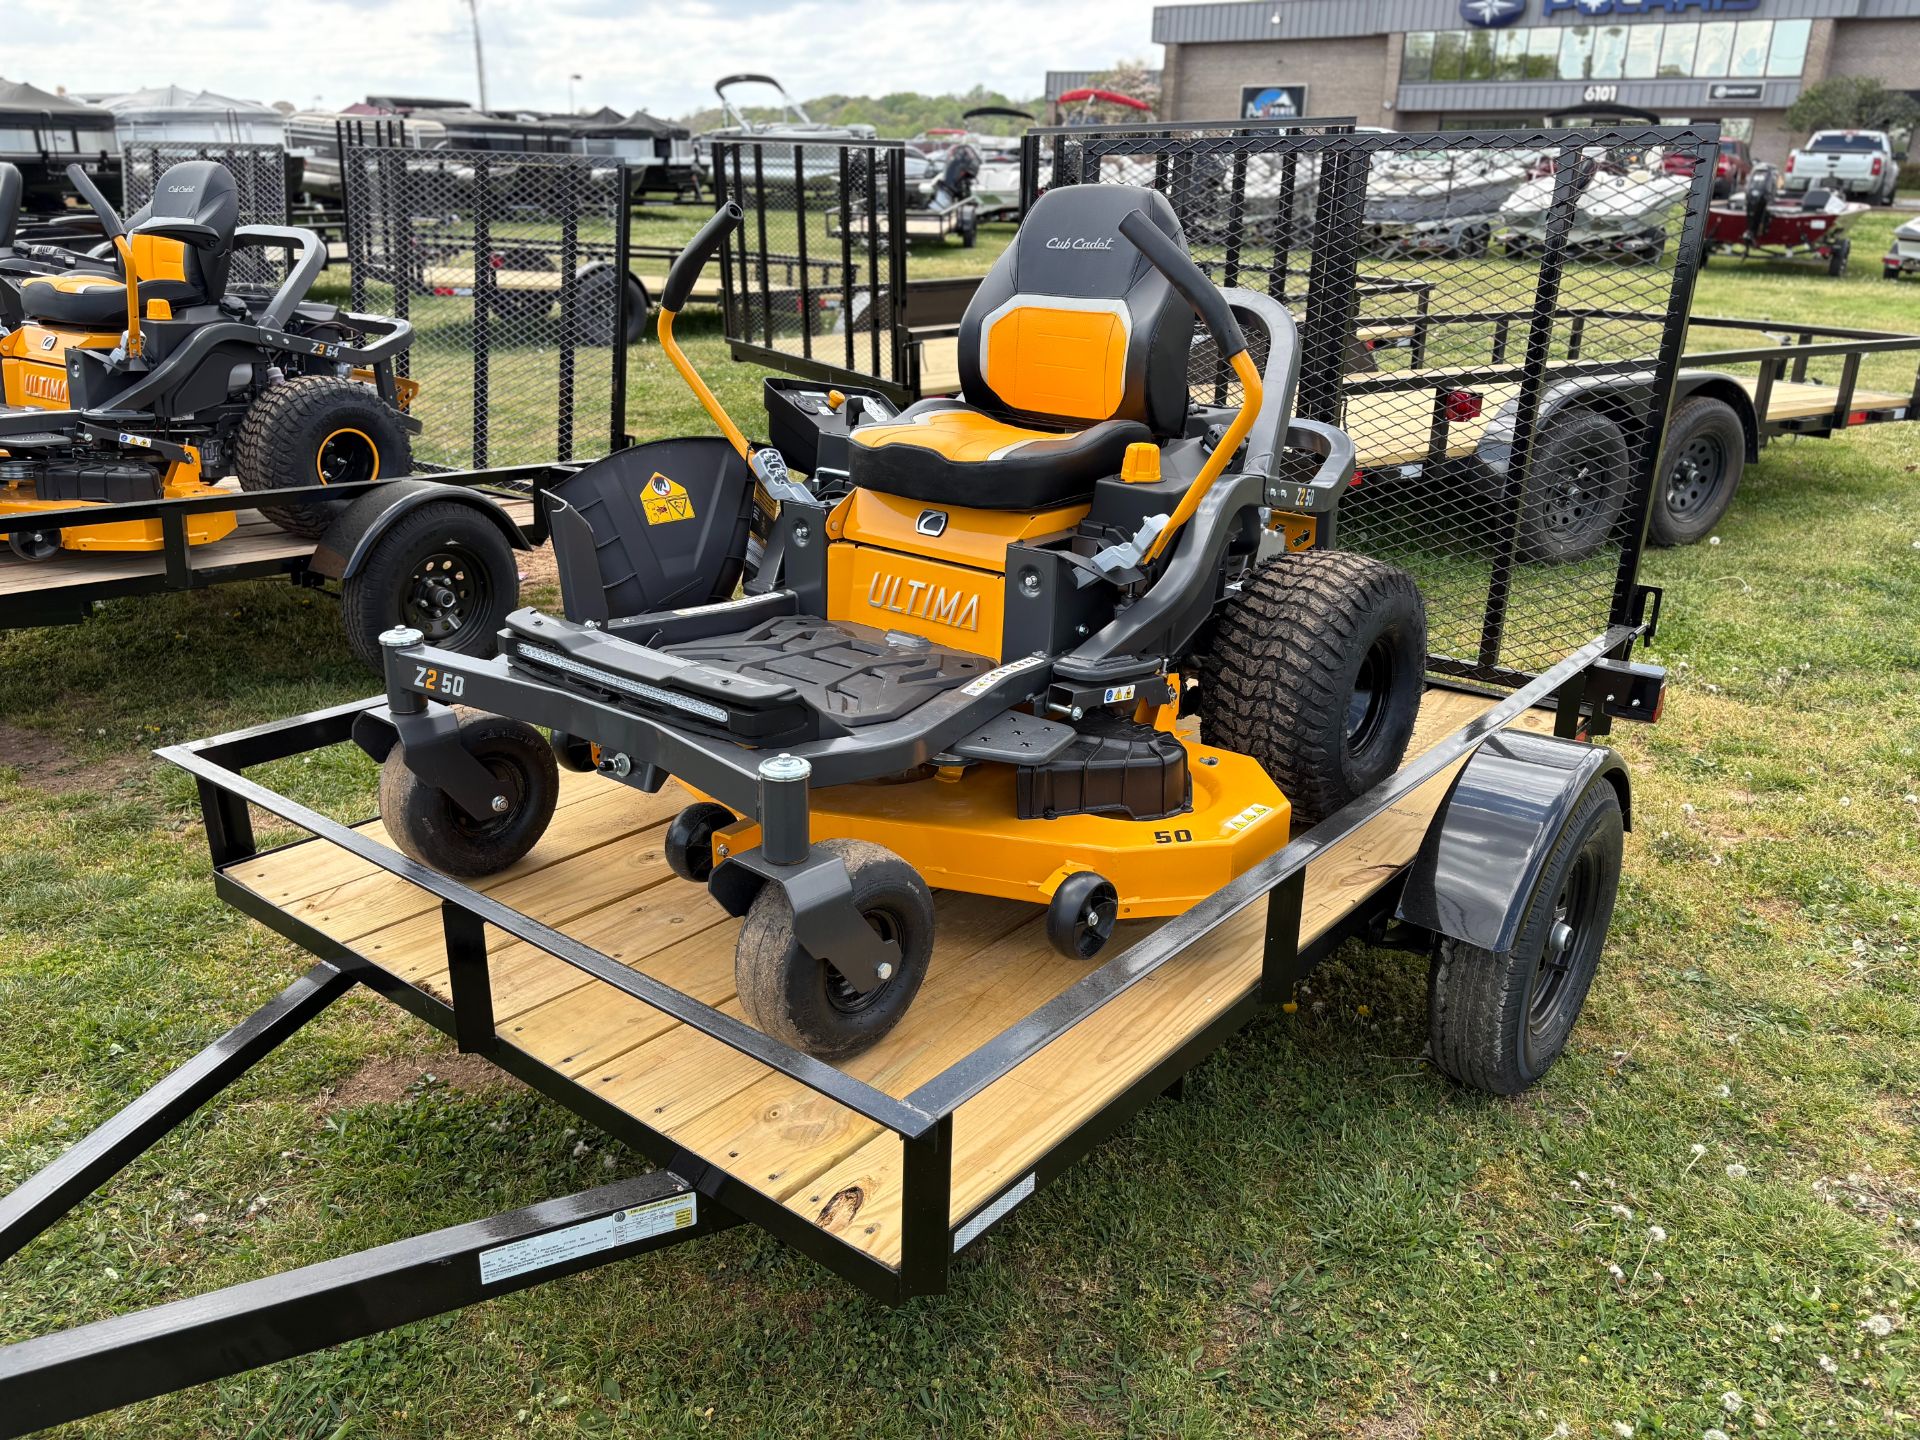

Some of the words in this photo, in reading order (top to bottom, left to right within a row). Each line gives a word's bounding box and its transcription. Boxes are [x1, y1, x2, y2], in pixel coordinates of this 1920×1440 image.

[1584, 85, 1617, 102] 6101
[1046, 237, 1071, 250] Cub
[1072, 237, 1114, 250] Cadet
[310, 342, 325, 355] Z3
[326, 345, 340, 358] 54
[24, 373, 68, 403] ULTIMA
[867, 571, 980, 631] ULTIMA
[413, 665, 438, 690] Z2
[441, 672, 465, 697] 50
[1154, 829, 1192, 844] 50
